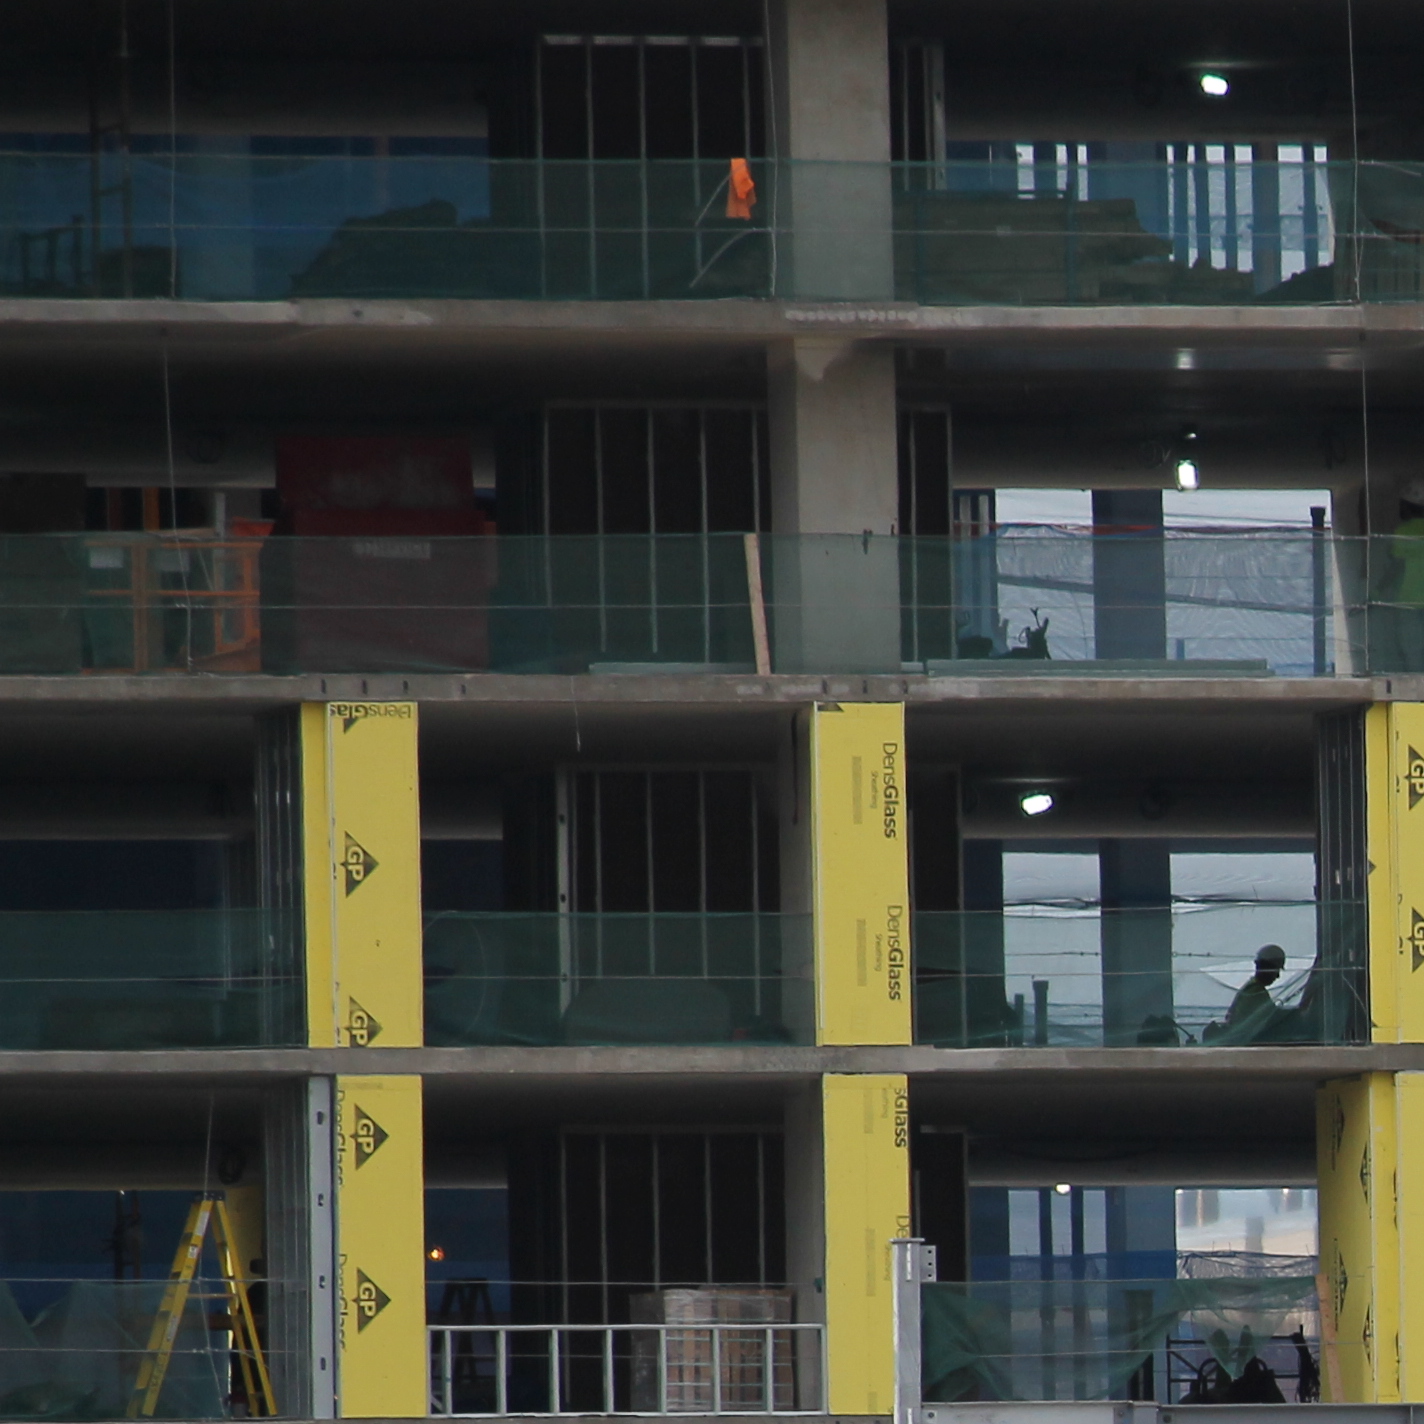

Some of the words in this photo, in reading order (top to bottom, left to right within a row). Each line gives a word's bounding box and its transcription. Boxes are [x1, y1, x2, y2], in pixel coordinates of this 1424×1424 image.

[882, 741, 900, 840] DensGlass
[347, 845, 365, 882] GP
[887, 904, 905, 1001] DensGlass
[351, 1009, 369, 1046] GP
[357, 1118, 375, 1154] GP
[358, 1280, 376, 1317] GP
